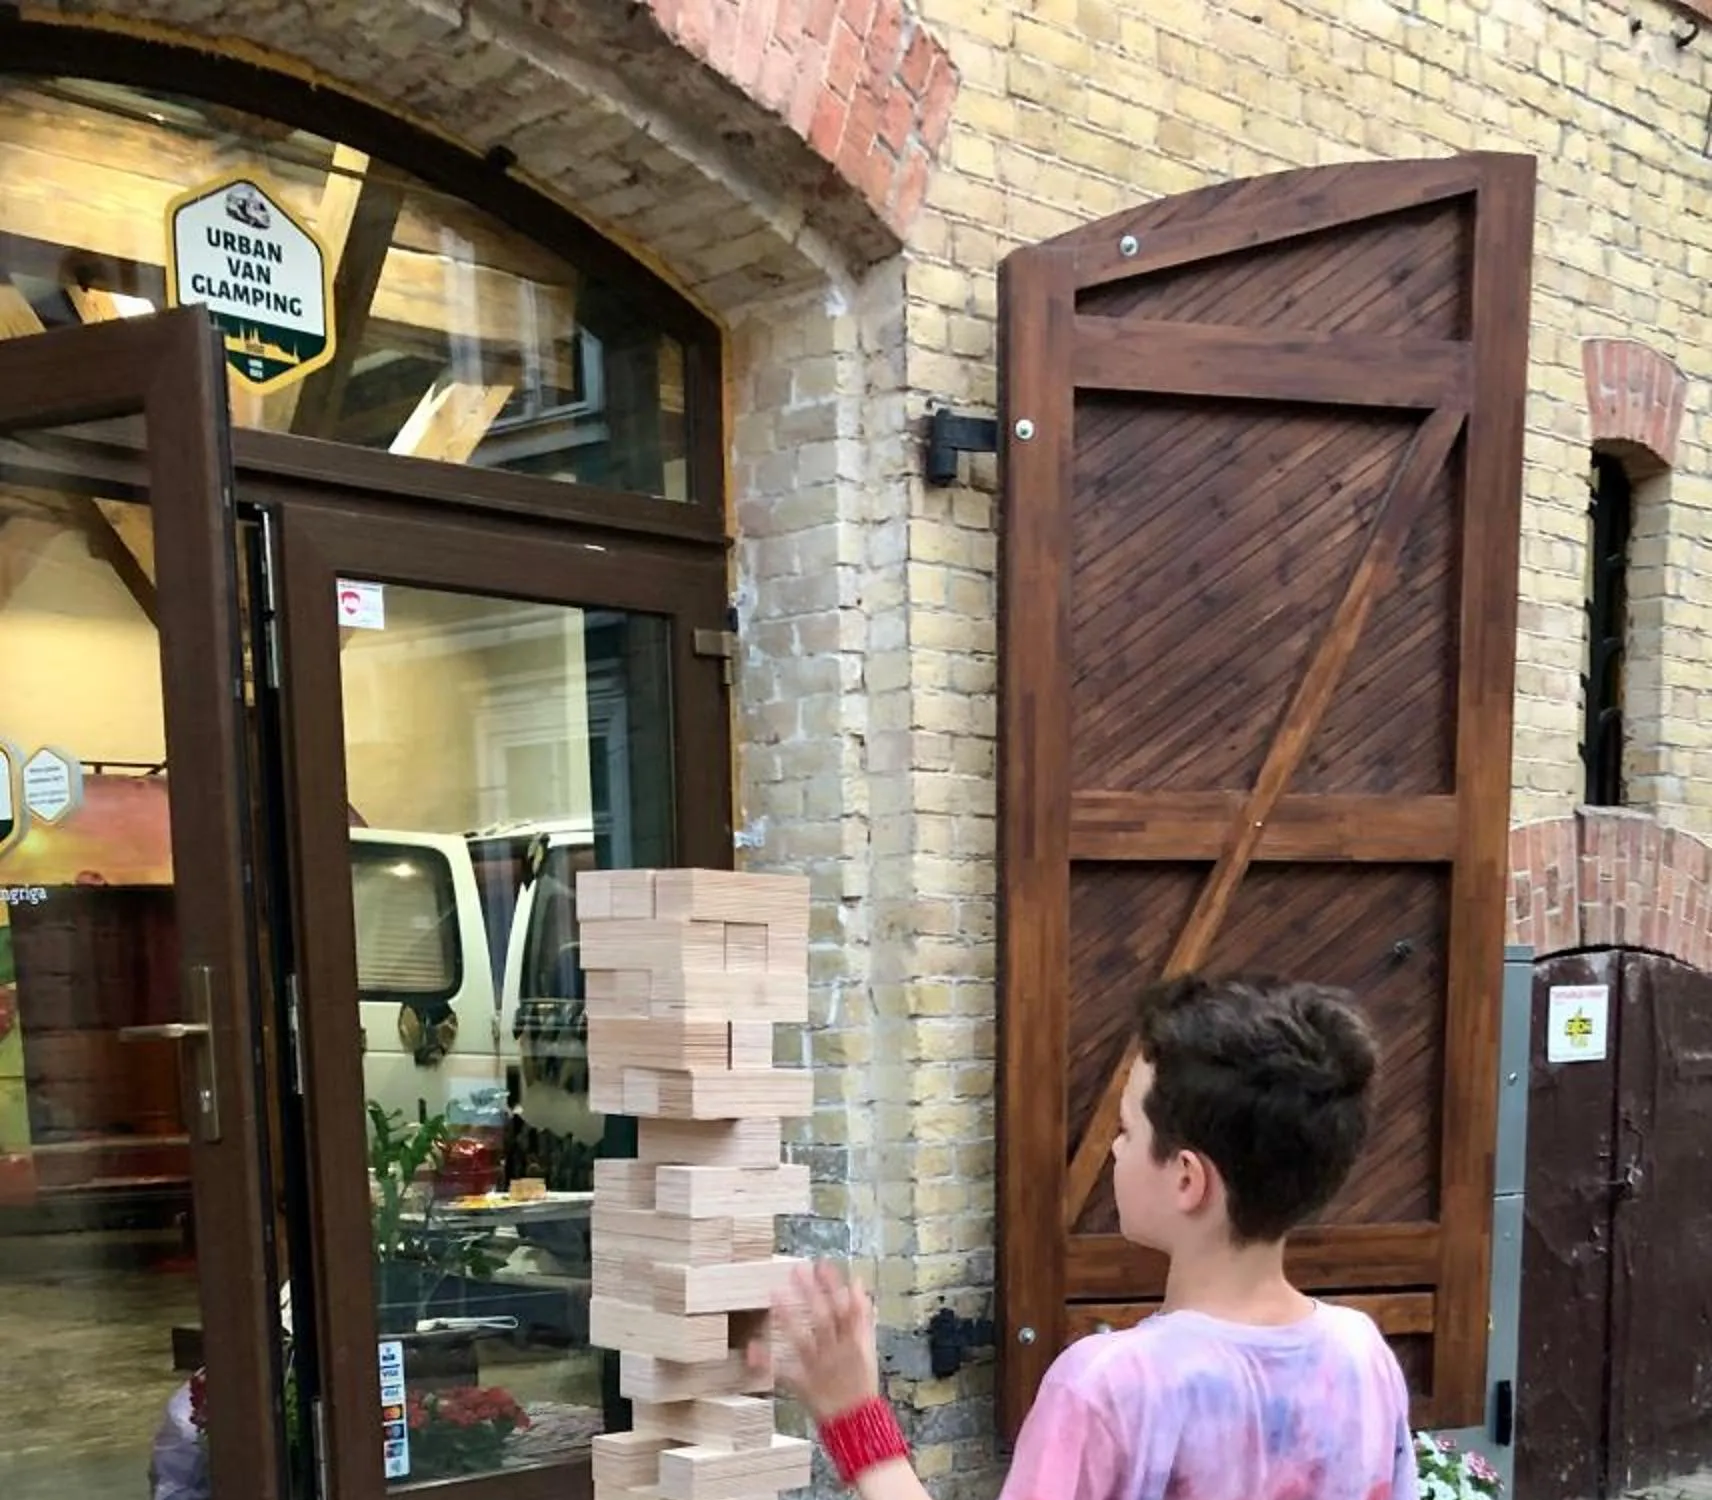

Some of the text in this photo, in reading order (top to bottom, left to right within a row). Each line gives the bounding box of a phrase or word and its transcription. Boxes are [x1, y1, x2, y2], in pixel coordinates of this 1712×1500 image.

[206, 226, 282, 263] URBAN
[227, 257, 271, 285] VAN
[191, 273, 303, 316] GLAMPING
